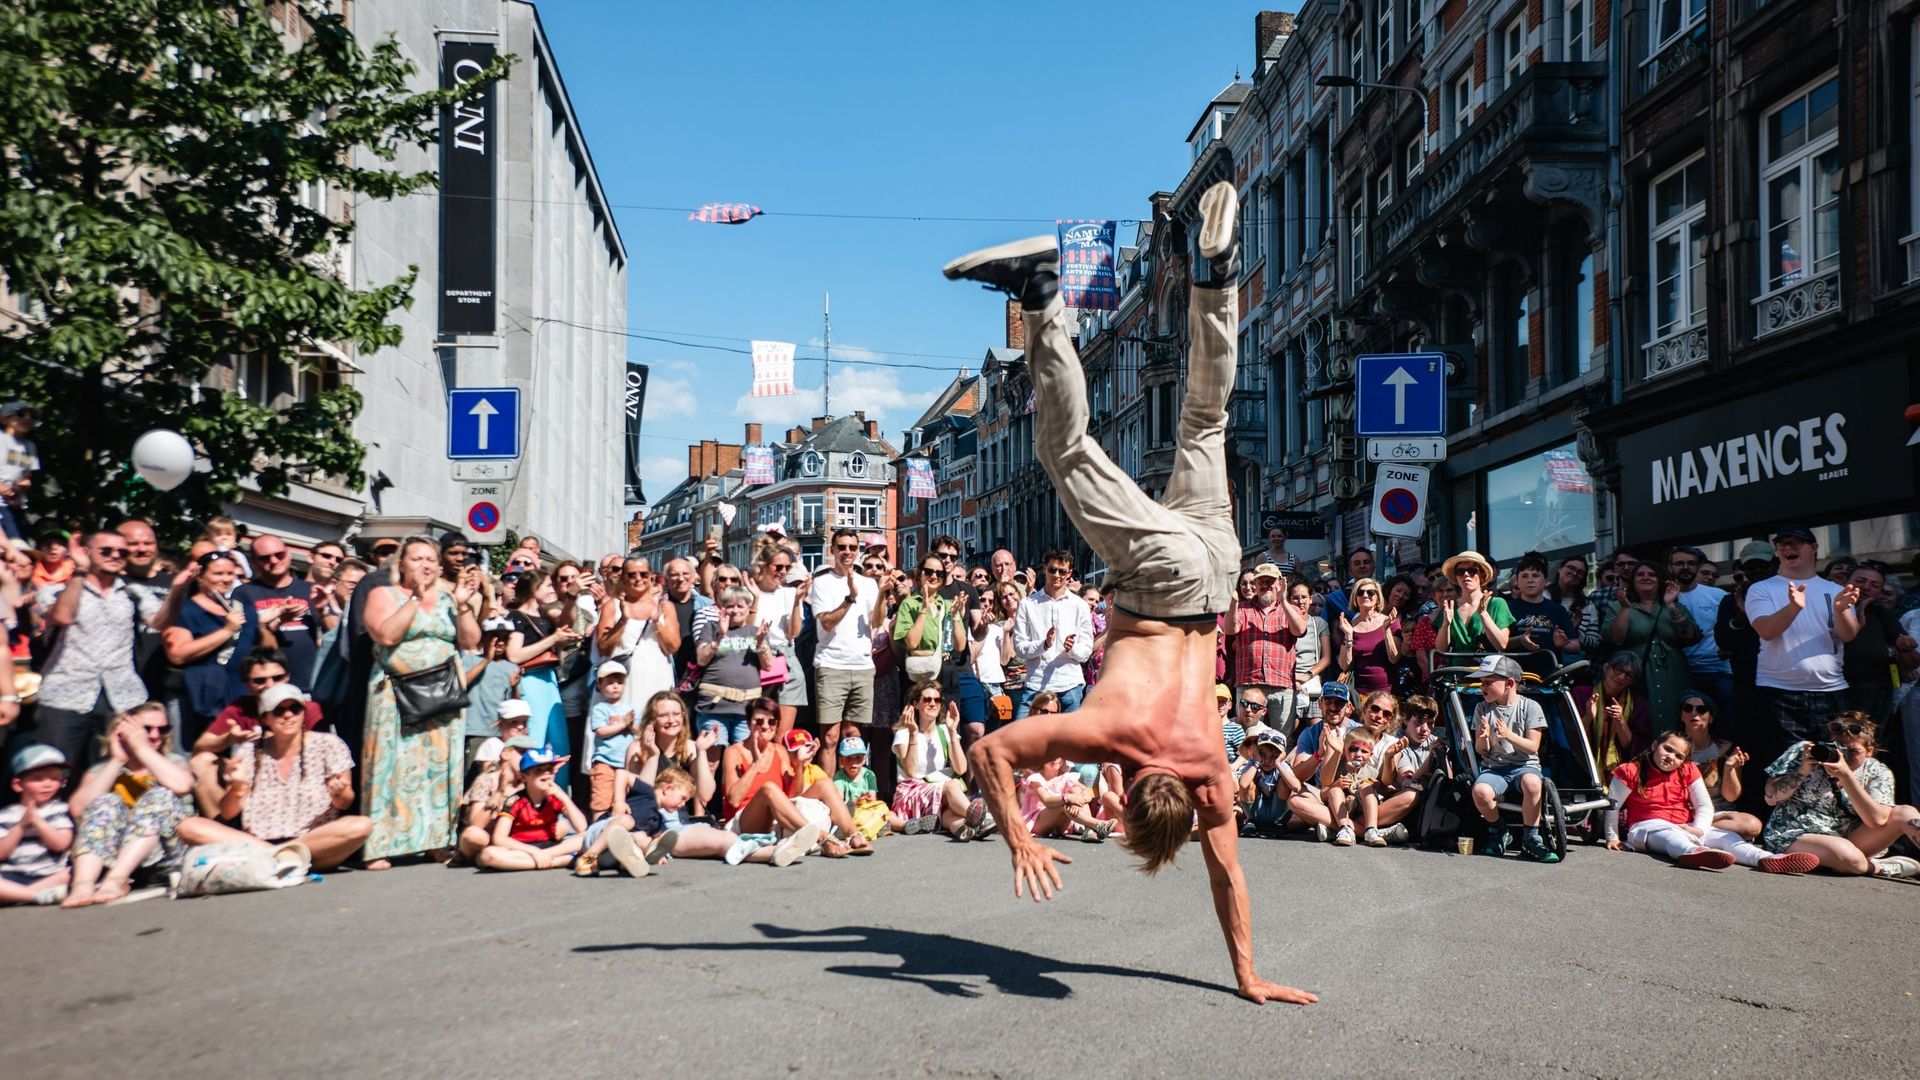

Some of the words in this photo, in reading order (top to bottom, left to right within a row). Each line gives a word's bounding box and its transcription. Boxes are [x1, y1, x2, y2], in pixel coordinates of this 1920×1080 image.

[1065, 229, 1110, 239] NAMUR
[446, 289, 492, 297] DEPARTMENT
[624, 371, 643, 420] INNO
[1652, 412, 1848, 504] MAXENCES
[1386, 470, 1420, 482] ZONE
[471, 487, 499, 495] ZONE
